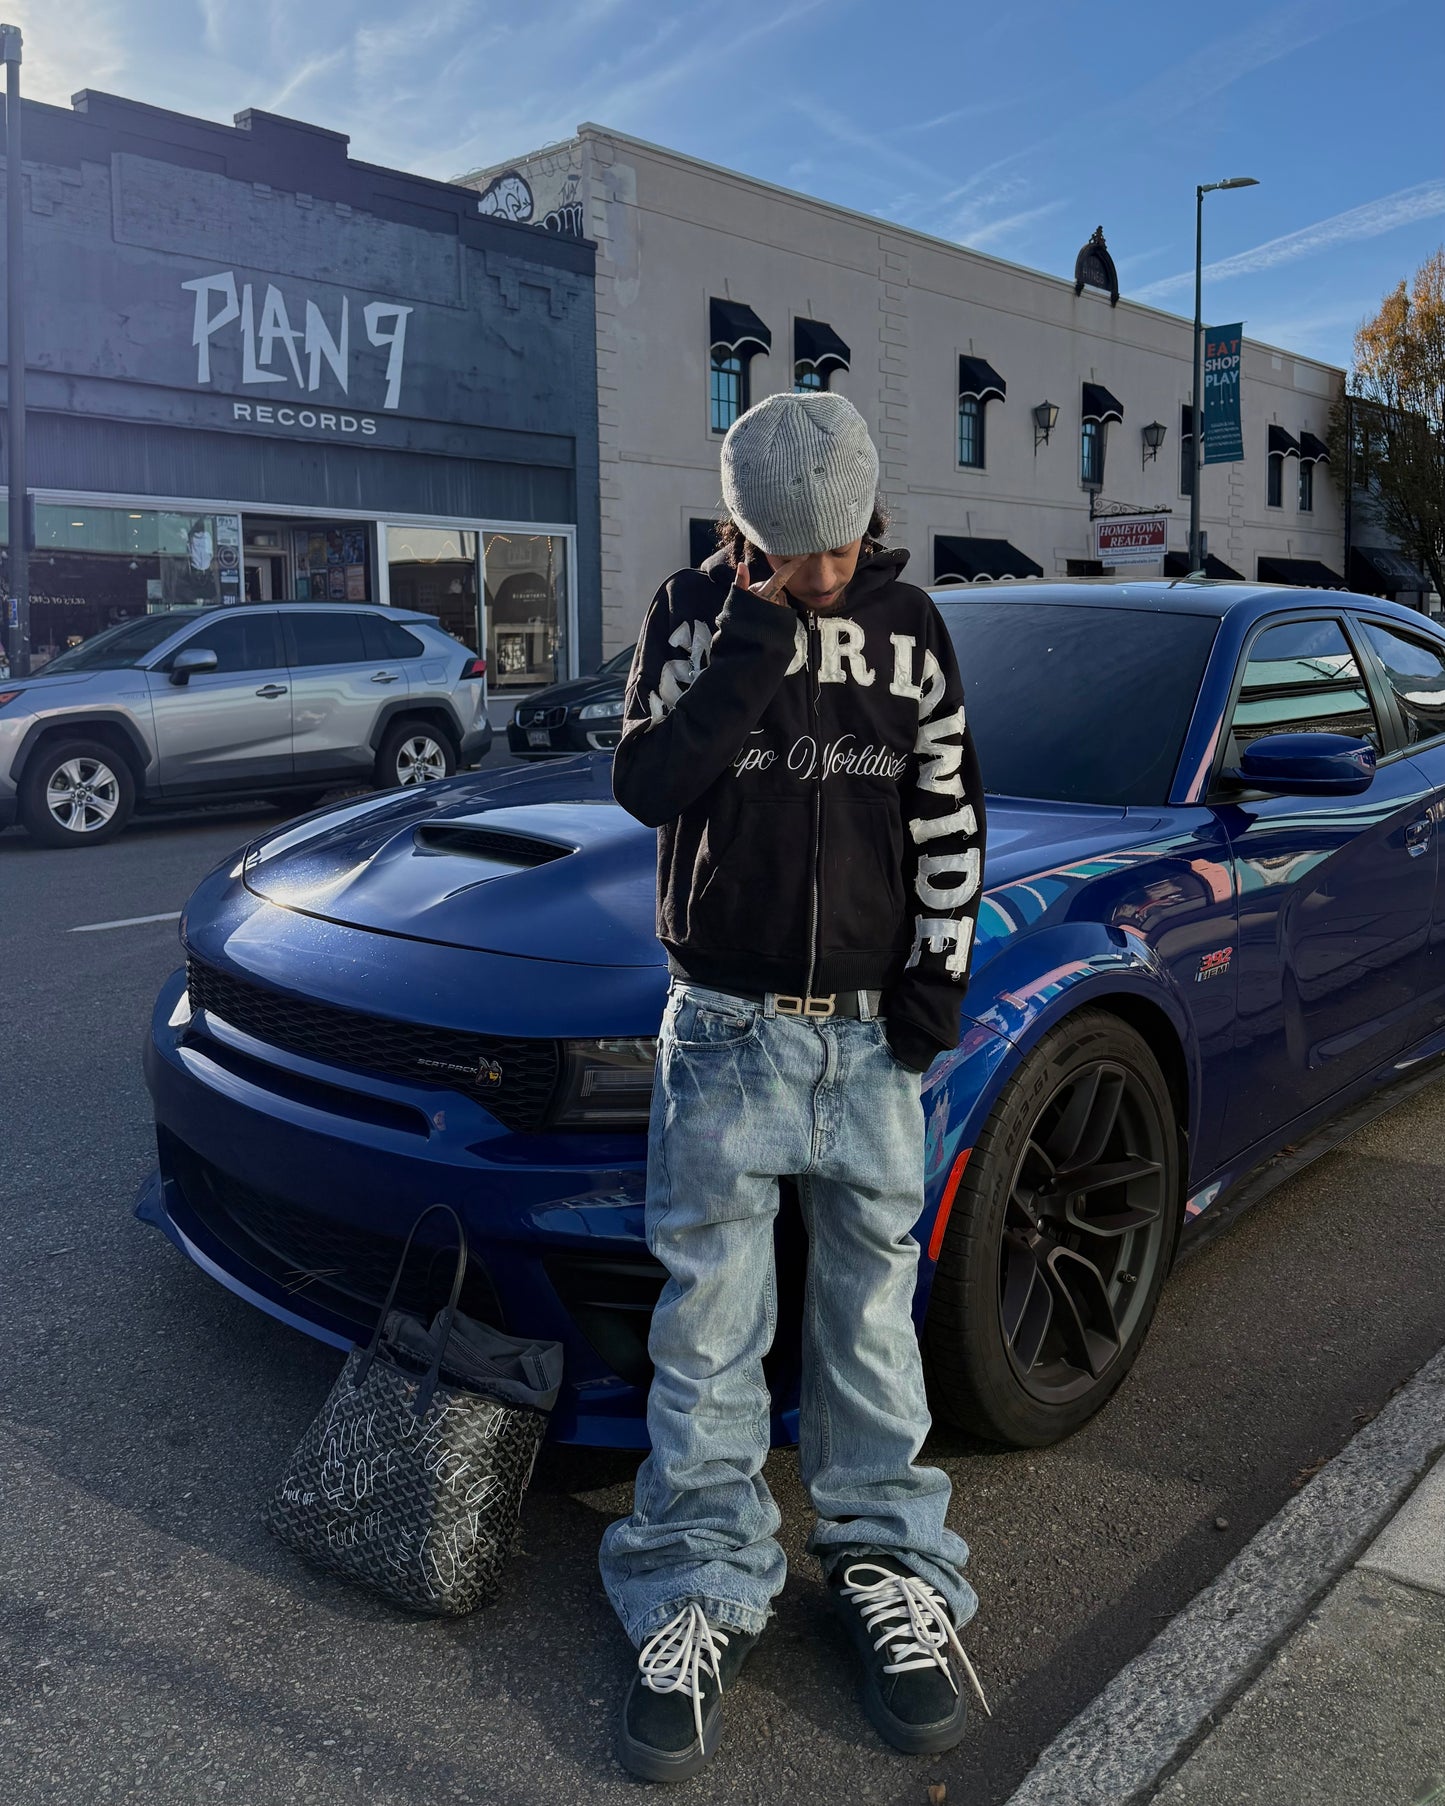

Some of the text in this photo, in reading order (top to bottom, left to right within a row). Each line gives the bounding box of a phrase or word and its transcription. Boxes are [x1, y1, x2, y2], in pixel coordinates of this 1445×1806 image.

[181, 271, 414, 409] PLAN 9
[1207, 340, 1239, 357] EAT
[1205, 356, 1239, 372] SHOP
[1205, 370, 1240, 387] PLAY
[233, 402, 378, 435] RECORDS
[1100, 522, 1164, 537] HOMETOWN
[1109, 534, 1152, 547] REALTY
[1200, 946, 1233, 972] 392
[417, 1058, 479, 1074] SCAT PACK
[318, 1391, 381, 1456] FUCK
[485, 1407, 518, 1440] OFF
[411, 1407, 472, 1492] FUCK
[354, 1447, 396, 1500] OFF
[326, 1509, 384, 1548] FUCK OFF
[418, 1510, 487, 1599] FUCK
